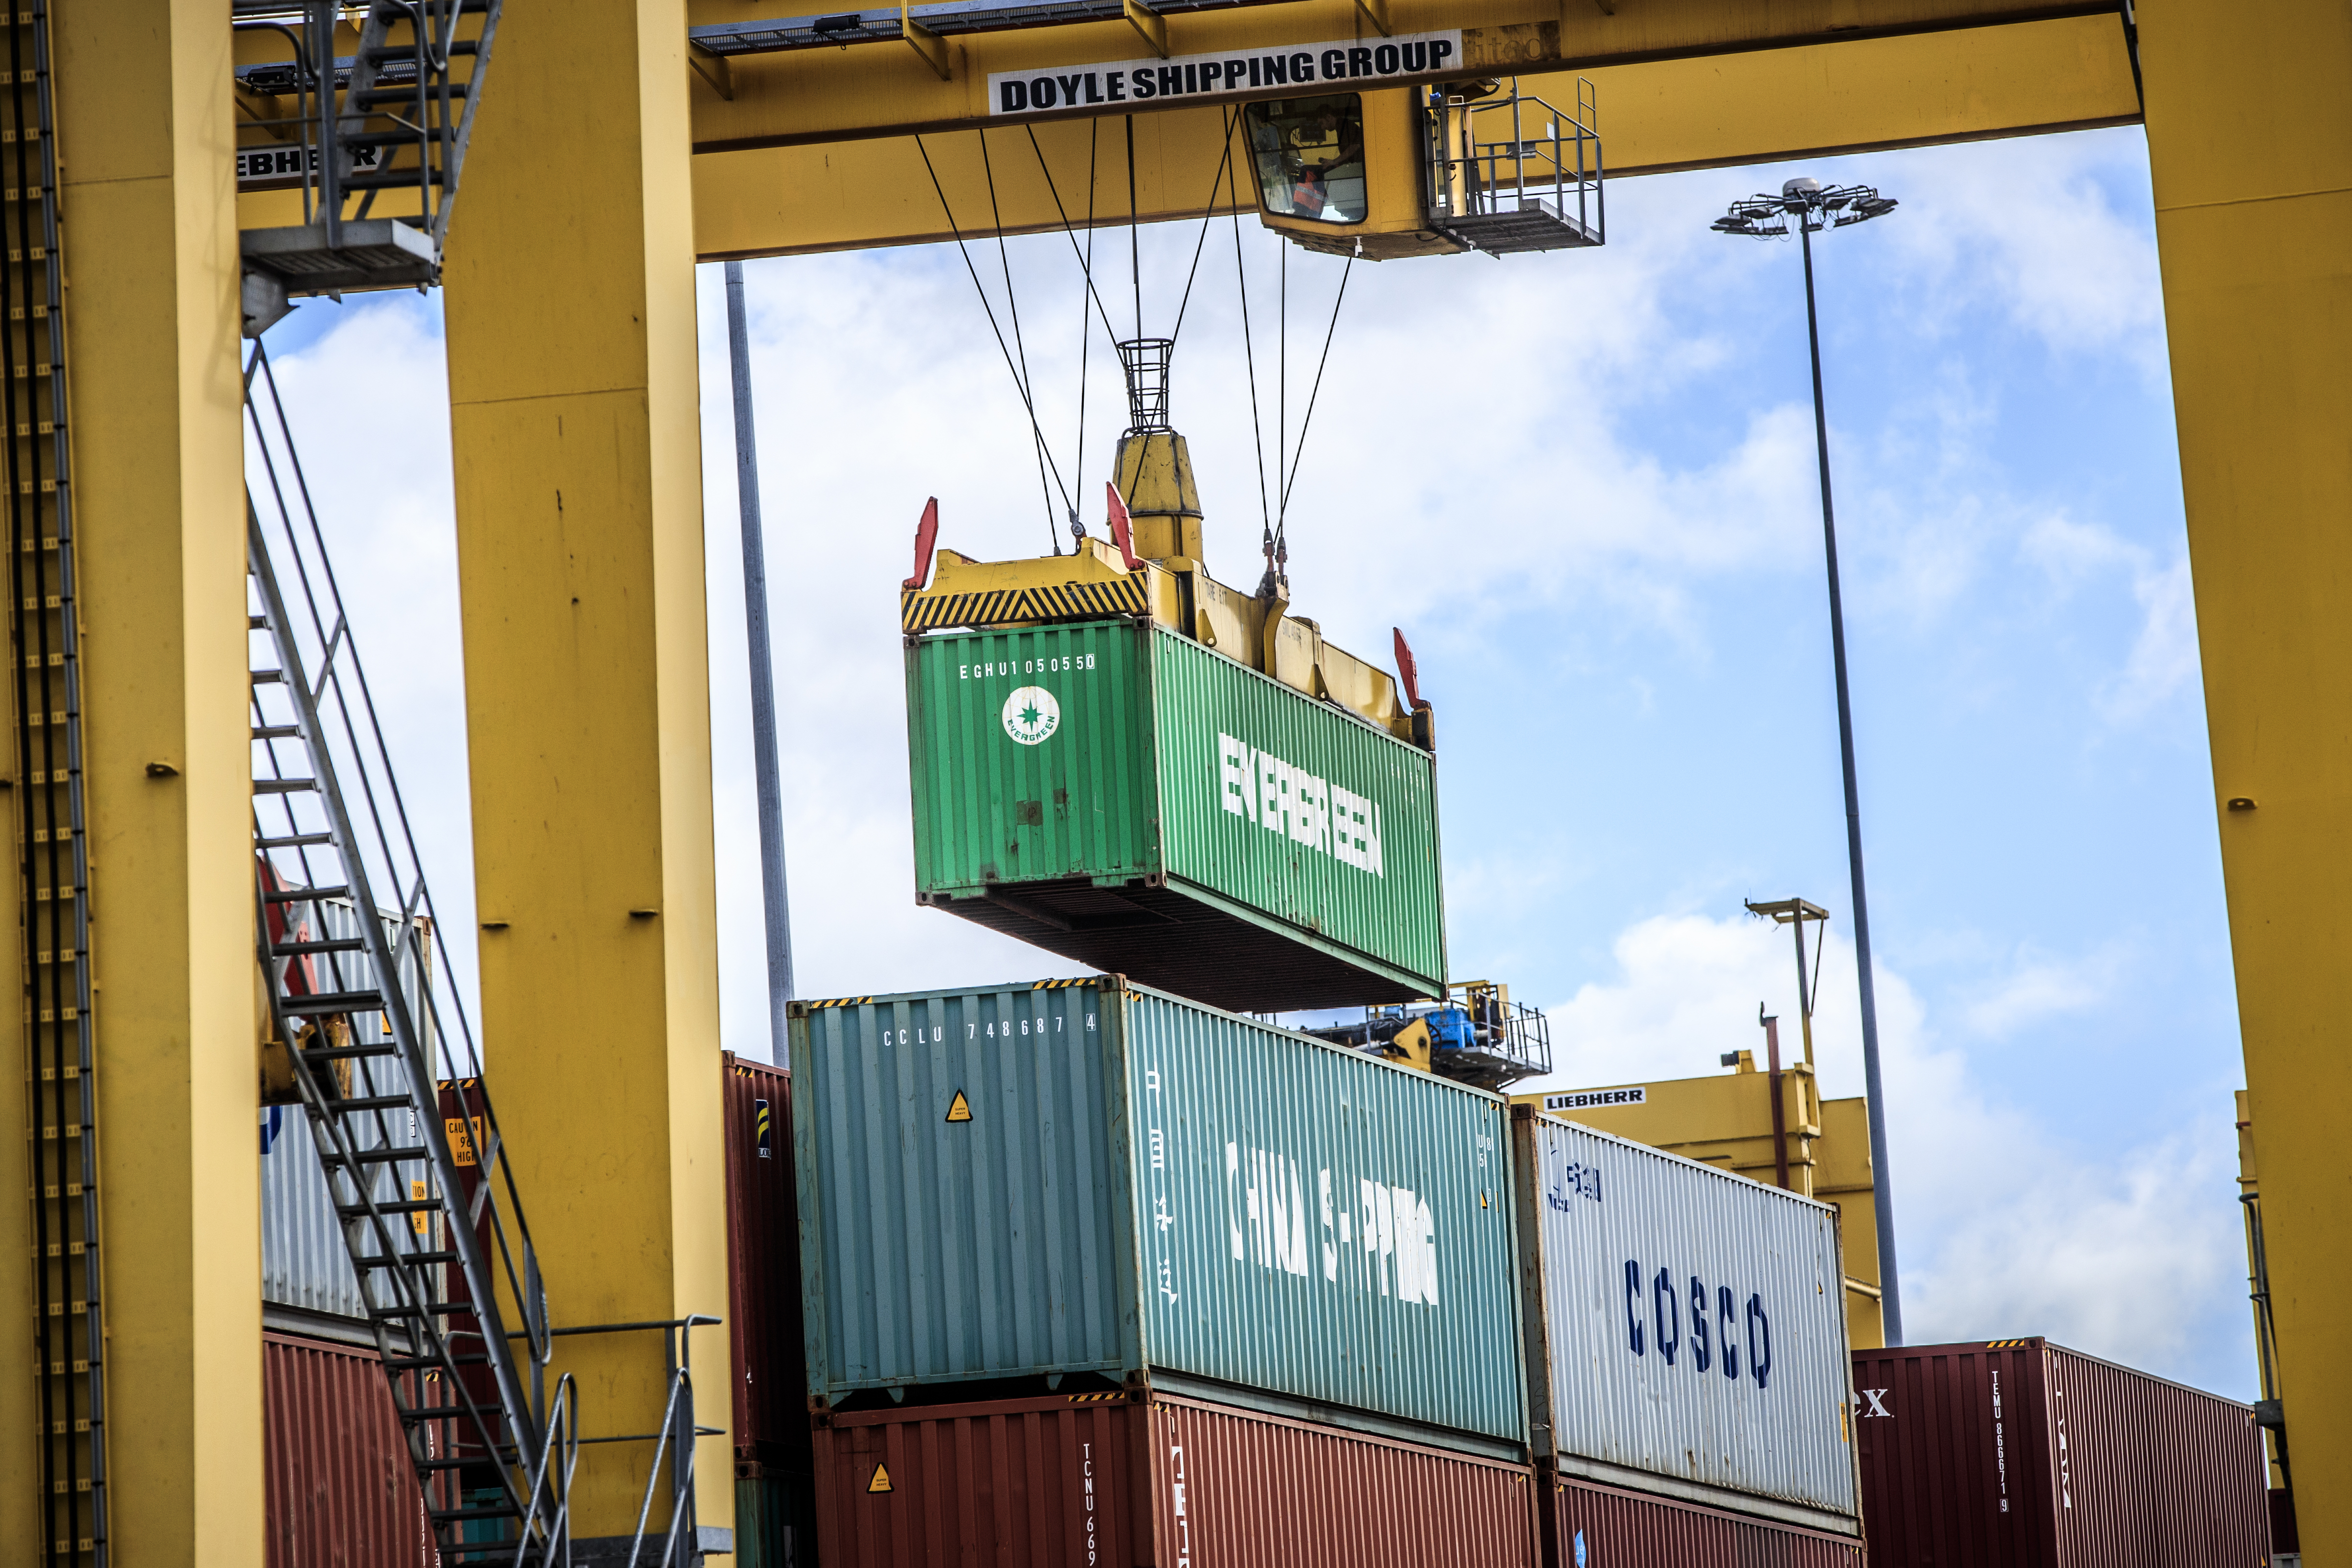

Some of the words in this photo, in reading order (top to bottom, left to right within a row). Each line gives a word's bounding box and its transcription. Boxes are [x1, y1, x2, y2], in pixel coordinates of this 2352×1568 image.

[1000, 71, 1125, 112] DOYLE
[1132, 52, 1314, 98] SHIPPING
[1321, 40, 1452, 79] GROUP
[1008, 716, 1055, 741] EVERGREEN
[1220, 732, 1383, 879] EVERGREEN
[884, 1026, 941, 1046] CCLU
[968, 1017, 1062, 1039] 748687
[1086, 1014, 1096, 1030] 4
[1547, 1090, 1642, 1109] LIEBHERR
[449, 1120, 478, 1134] CAUN
[1227, 1142, 1309, 1277] CHINA
[1624, 1259, 1771, 1389] COSCO
[1992, 1371, 2001, 1418] TEMU
[1083, 1443, 1094, 1511] TCNU
[1996, 1423, 2006, 1494] 866671
[2000, 1499, 2008, 1512] 9
[1087, 1516, 1096, 1567] 669
